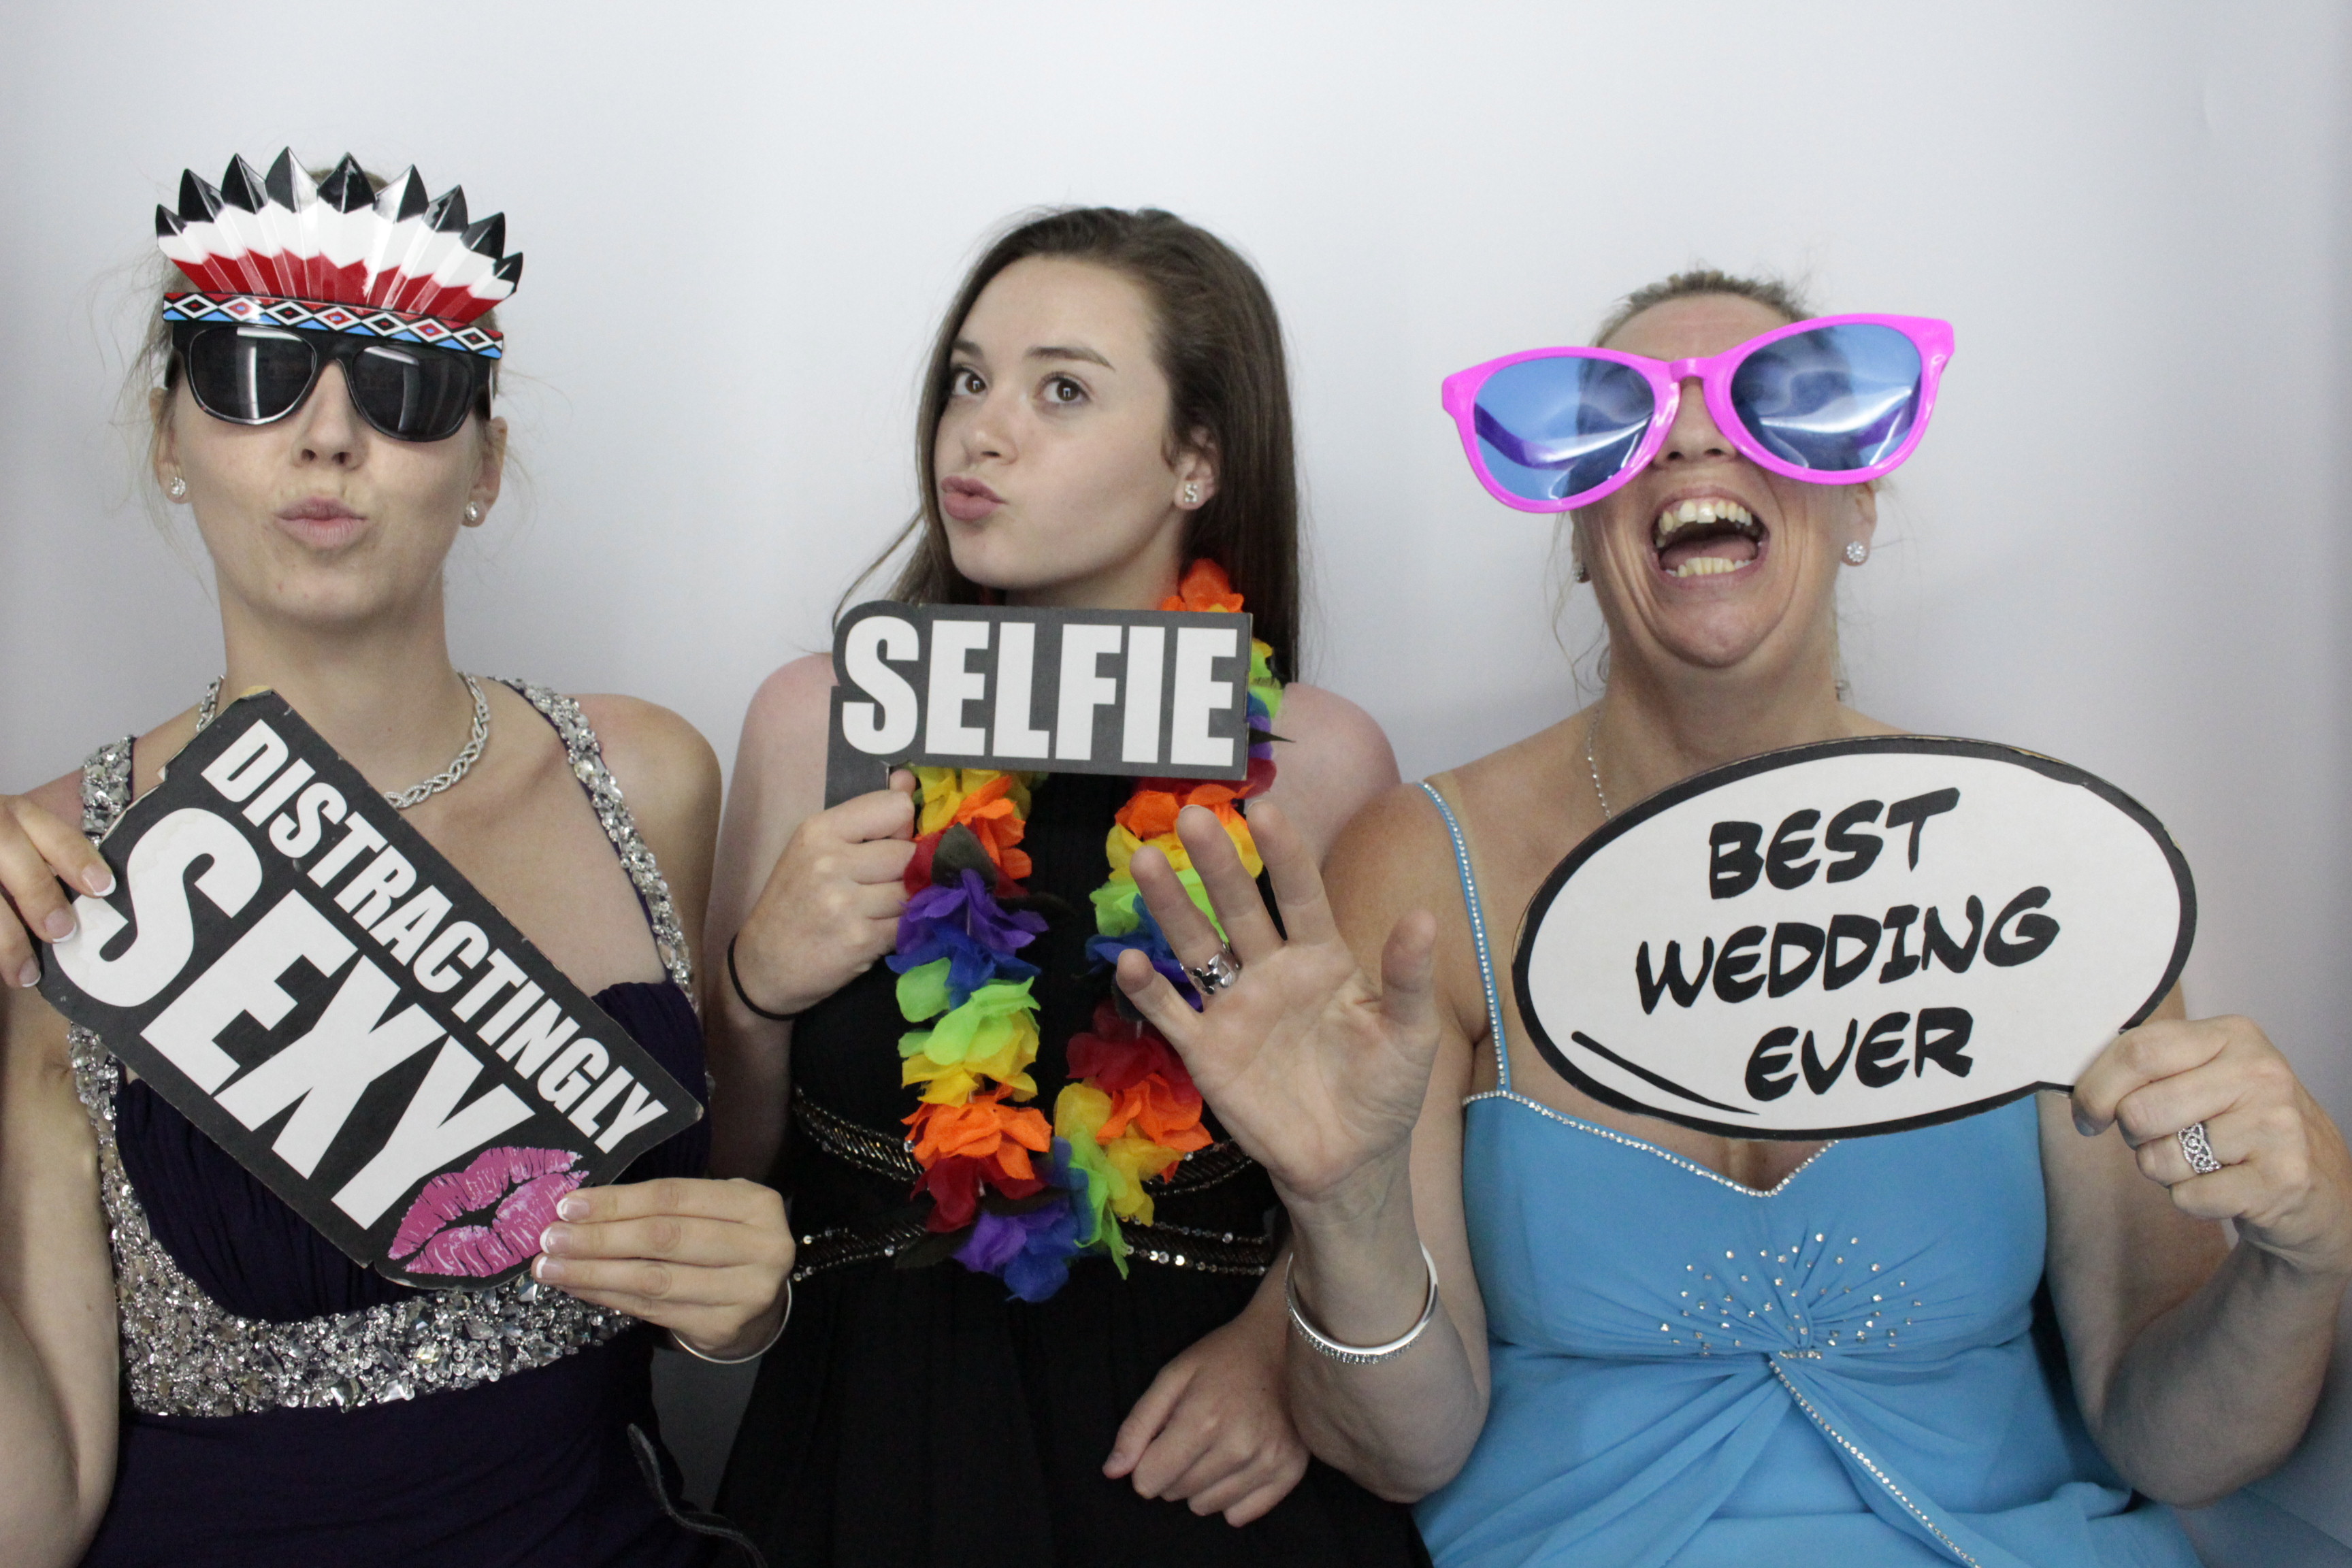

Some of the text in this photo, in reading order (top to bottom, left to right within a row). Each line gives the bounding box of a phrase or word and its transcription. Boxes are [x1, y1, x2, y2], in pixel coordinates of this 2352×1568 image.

[842, 616, 1237, 766] SELFIE
[1710, 787, 1960, 899] BEST
[201, 719, 668, 1154] DISTRACTINGLY
[1636, 886, 2060, 1015] WEDDING
[52, 808, 535, 1230] SEXY
[1745, 1007, 1974, 1101] EVER
